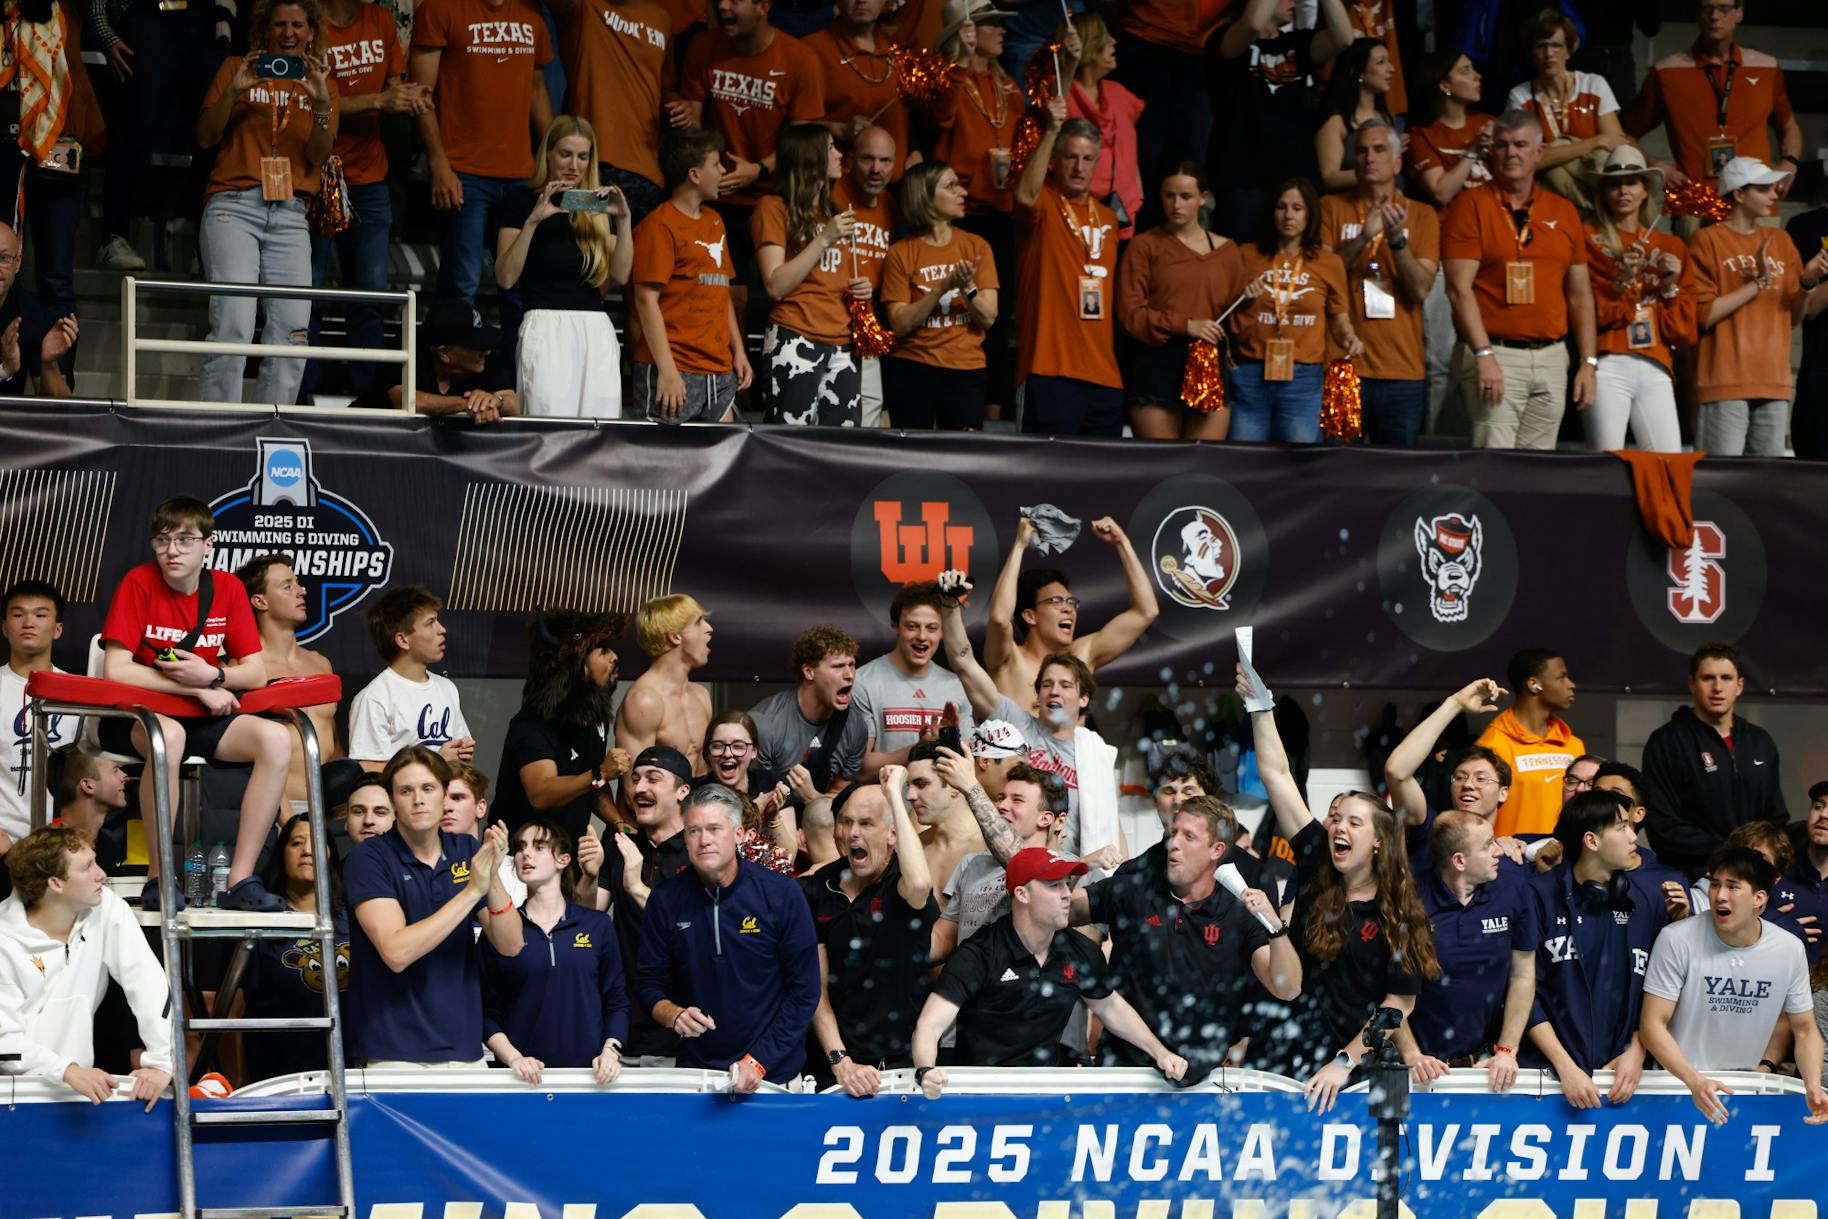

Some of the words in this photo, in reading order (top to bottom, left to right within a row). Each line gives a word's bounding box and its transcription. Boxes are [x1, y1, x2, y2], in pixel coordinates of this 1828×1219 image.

[467, 21, 535, 46] TEXAS
[322, 39, 386, 71] TEXAS
[712, 68, 777, 101] TEXAS
[820, 247, 842, 273] UP
[270, 466, 301, 478] NCAA
[254, 514, 293, 528] 2025
[296, 516, 315, 529] DI
[211, 530, 292, 545] SWIMMING
[294, 533, 305, 544] &
[307, 535, 360, 546] DIVING
[417, 703, 453, 741] Cal
[886, 713, 922, 726] HOOSIER
[450, 861, 470, 876] Cal
[742, 916, 757, 929] Cal
[1481, 916, 1509, 931] YALE
[575, 932, 590, 944] Cal
[1704, 976, 1772, 998] YALE
[1709, 997, 1759, 1007] SWIMMING
[1720, 1005, 1753, 1014] DIVING
[815, 1124, 1034, 1184] 2025
[1070, 1123, 1278, 1182] NCAA
[1317, 1123, 1708, 1182] DVISION
[1743, 1124, 1782, 1182] I
